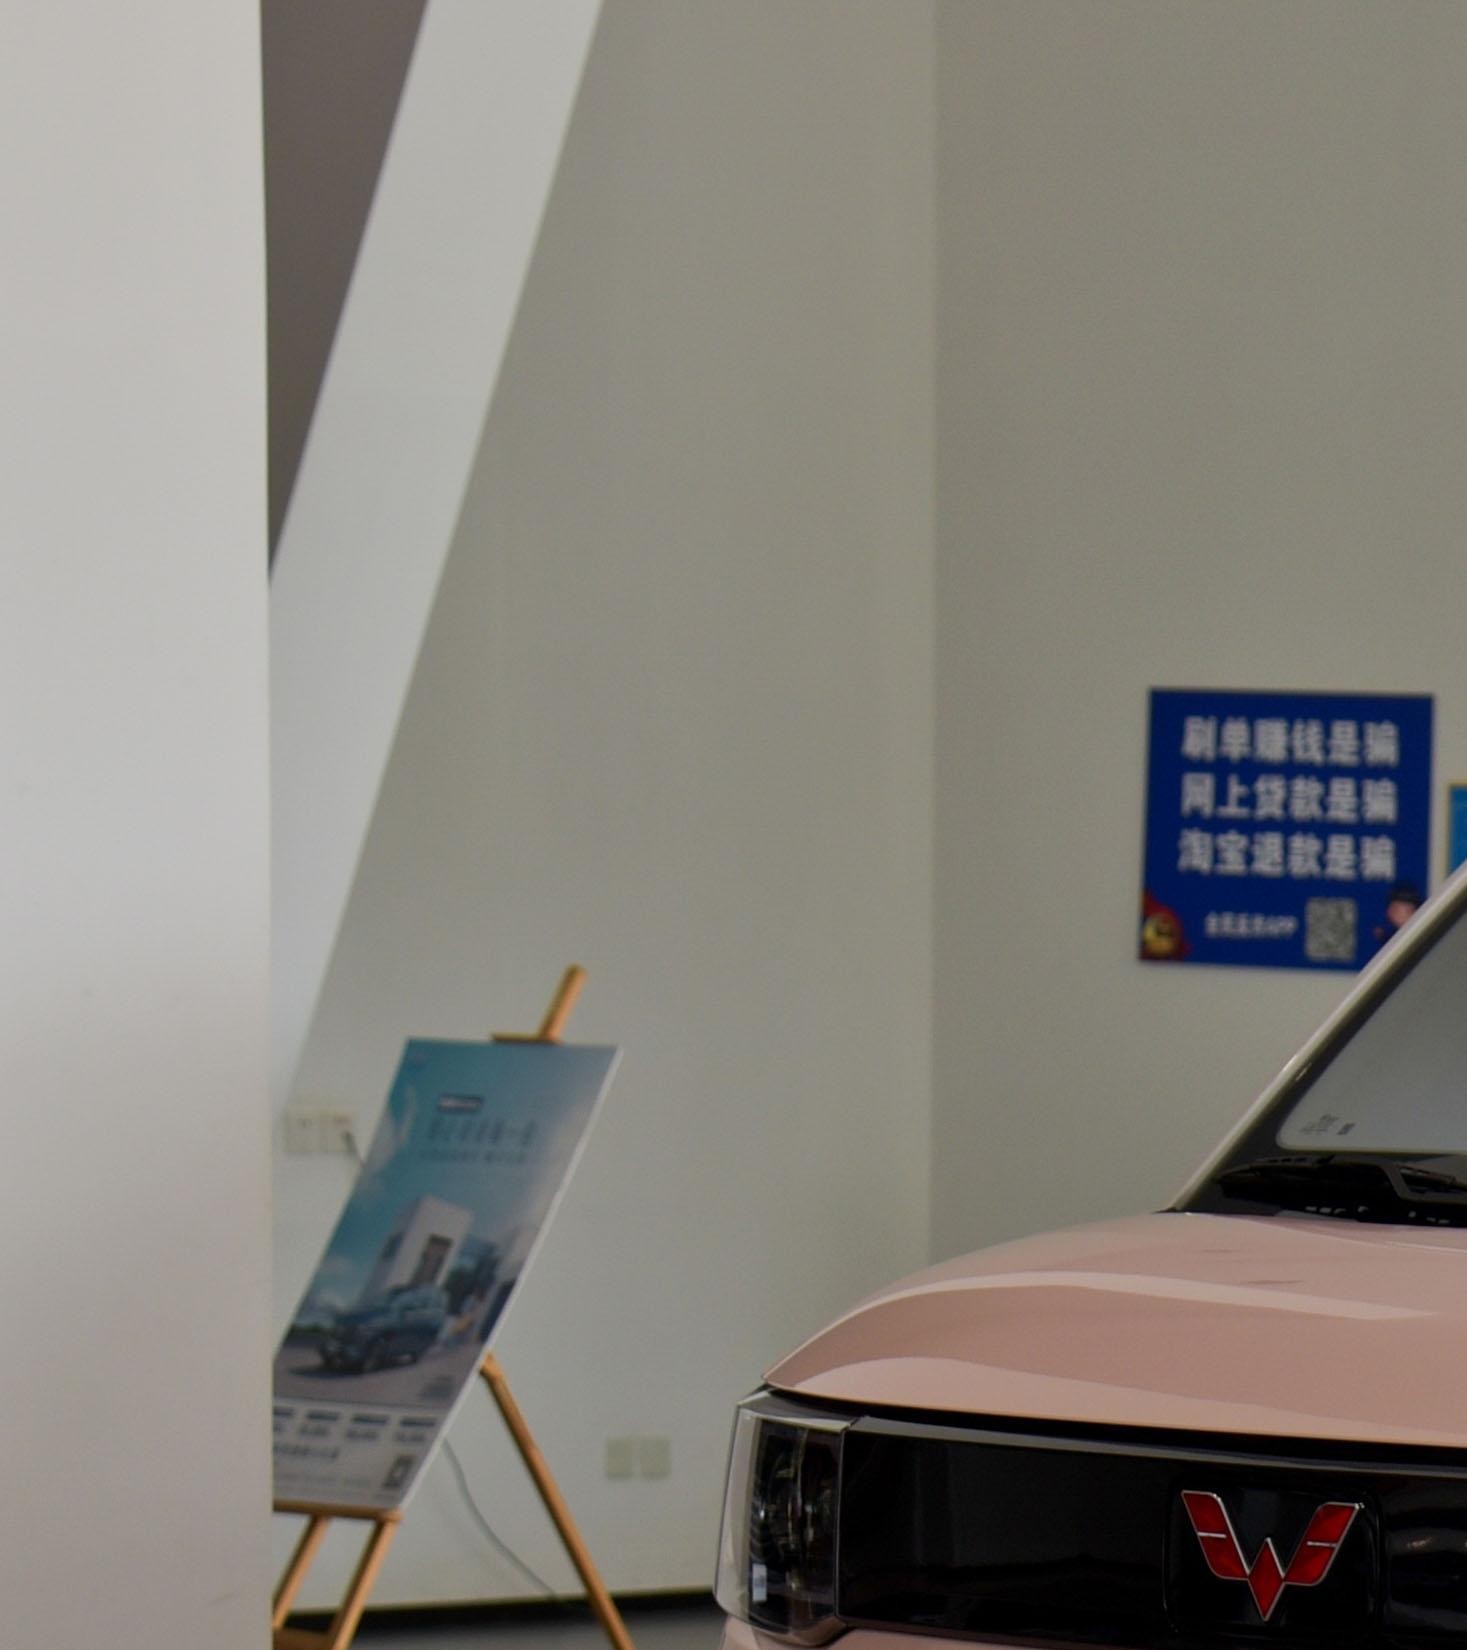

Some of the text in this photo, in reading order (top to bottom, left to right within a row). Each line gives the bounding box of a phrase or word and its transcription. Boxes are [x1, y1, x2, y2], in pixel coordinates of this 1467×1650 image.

[1181, 715, 1400, 768] 刷单赚钱是骗
[1180, 771, 1399, 825] 网上贷款是骗
[1176, 827, 1397, 882] 淘宝退款是骗
